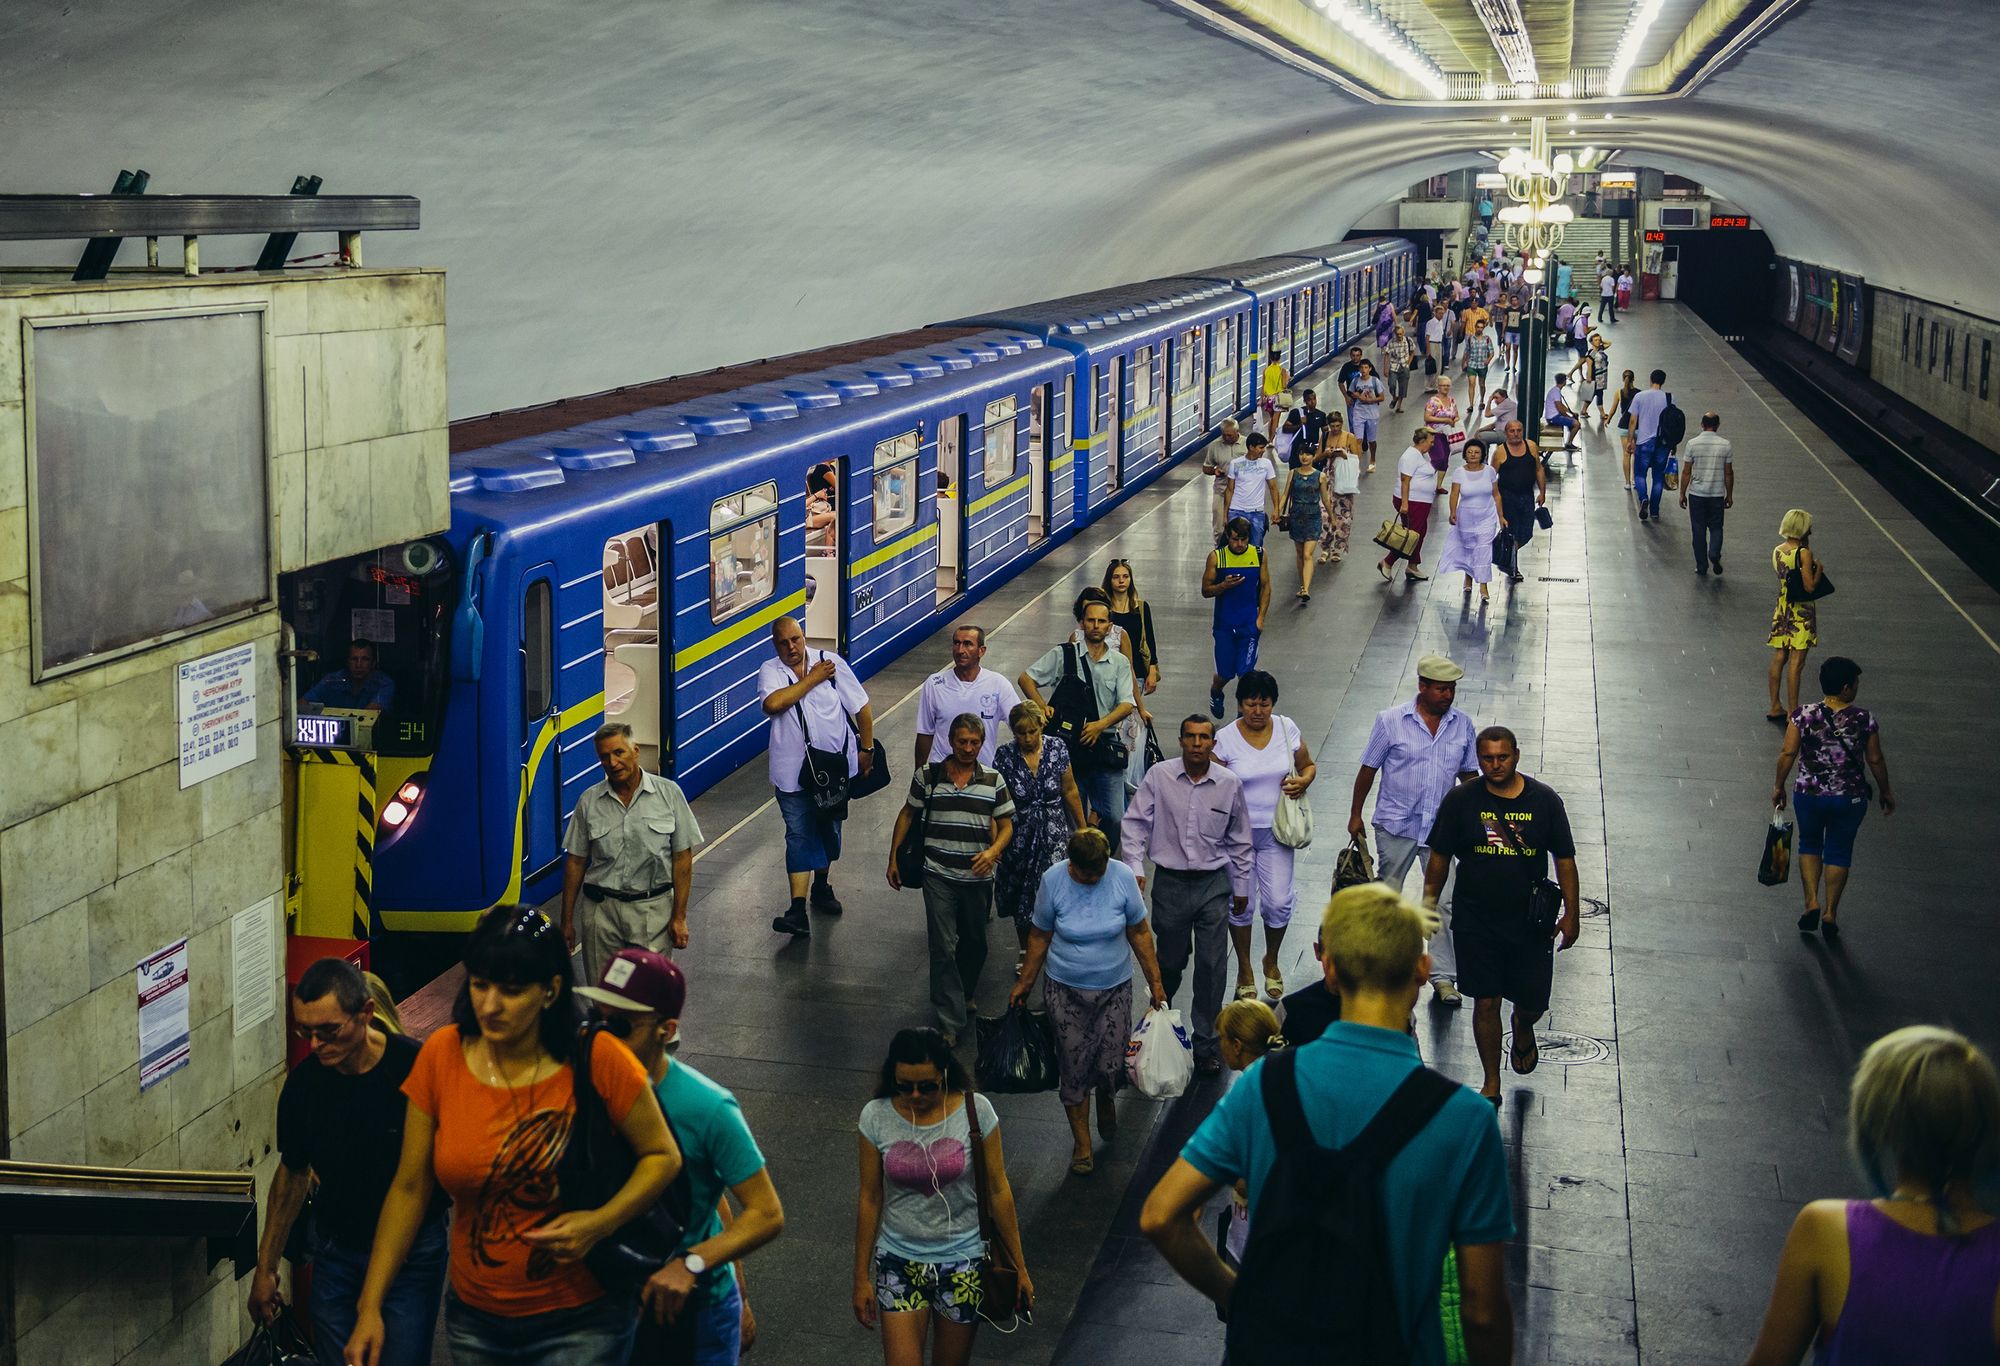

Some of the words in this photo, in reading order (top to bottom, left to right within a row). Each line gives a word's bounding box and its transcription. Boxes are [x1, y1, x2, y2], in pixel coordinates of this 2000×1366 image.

[1901, 312, 1998, 403] ХАРКІВ
[298, 718, 339, 744] ХУТІР
[400, 722, 425, 742] 34
[1480, 811, 1533, 821] OPEATION
[1474, 845, 1496, 855] IRAQI
